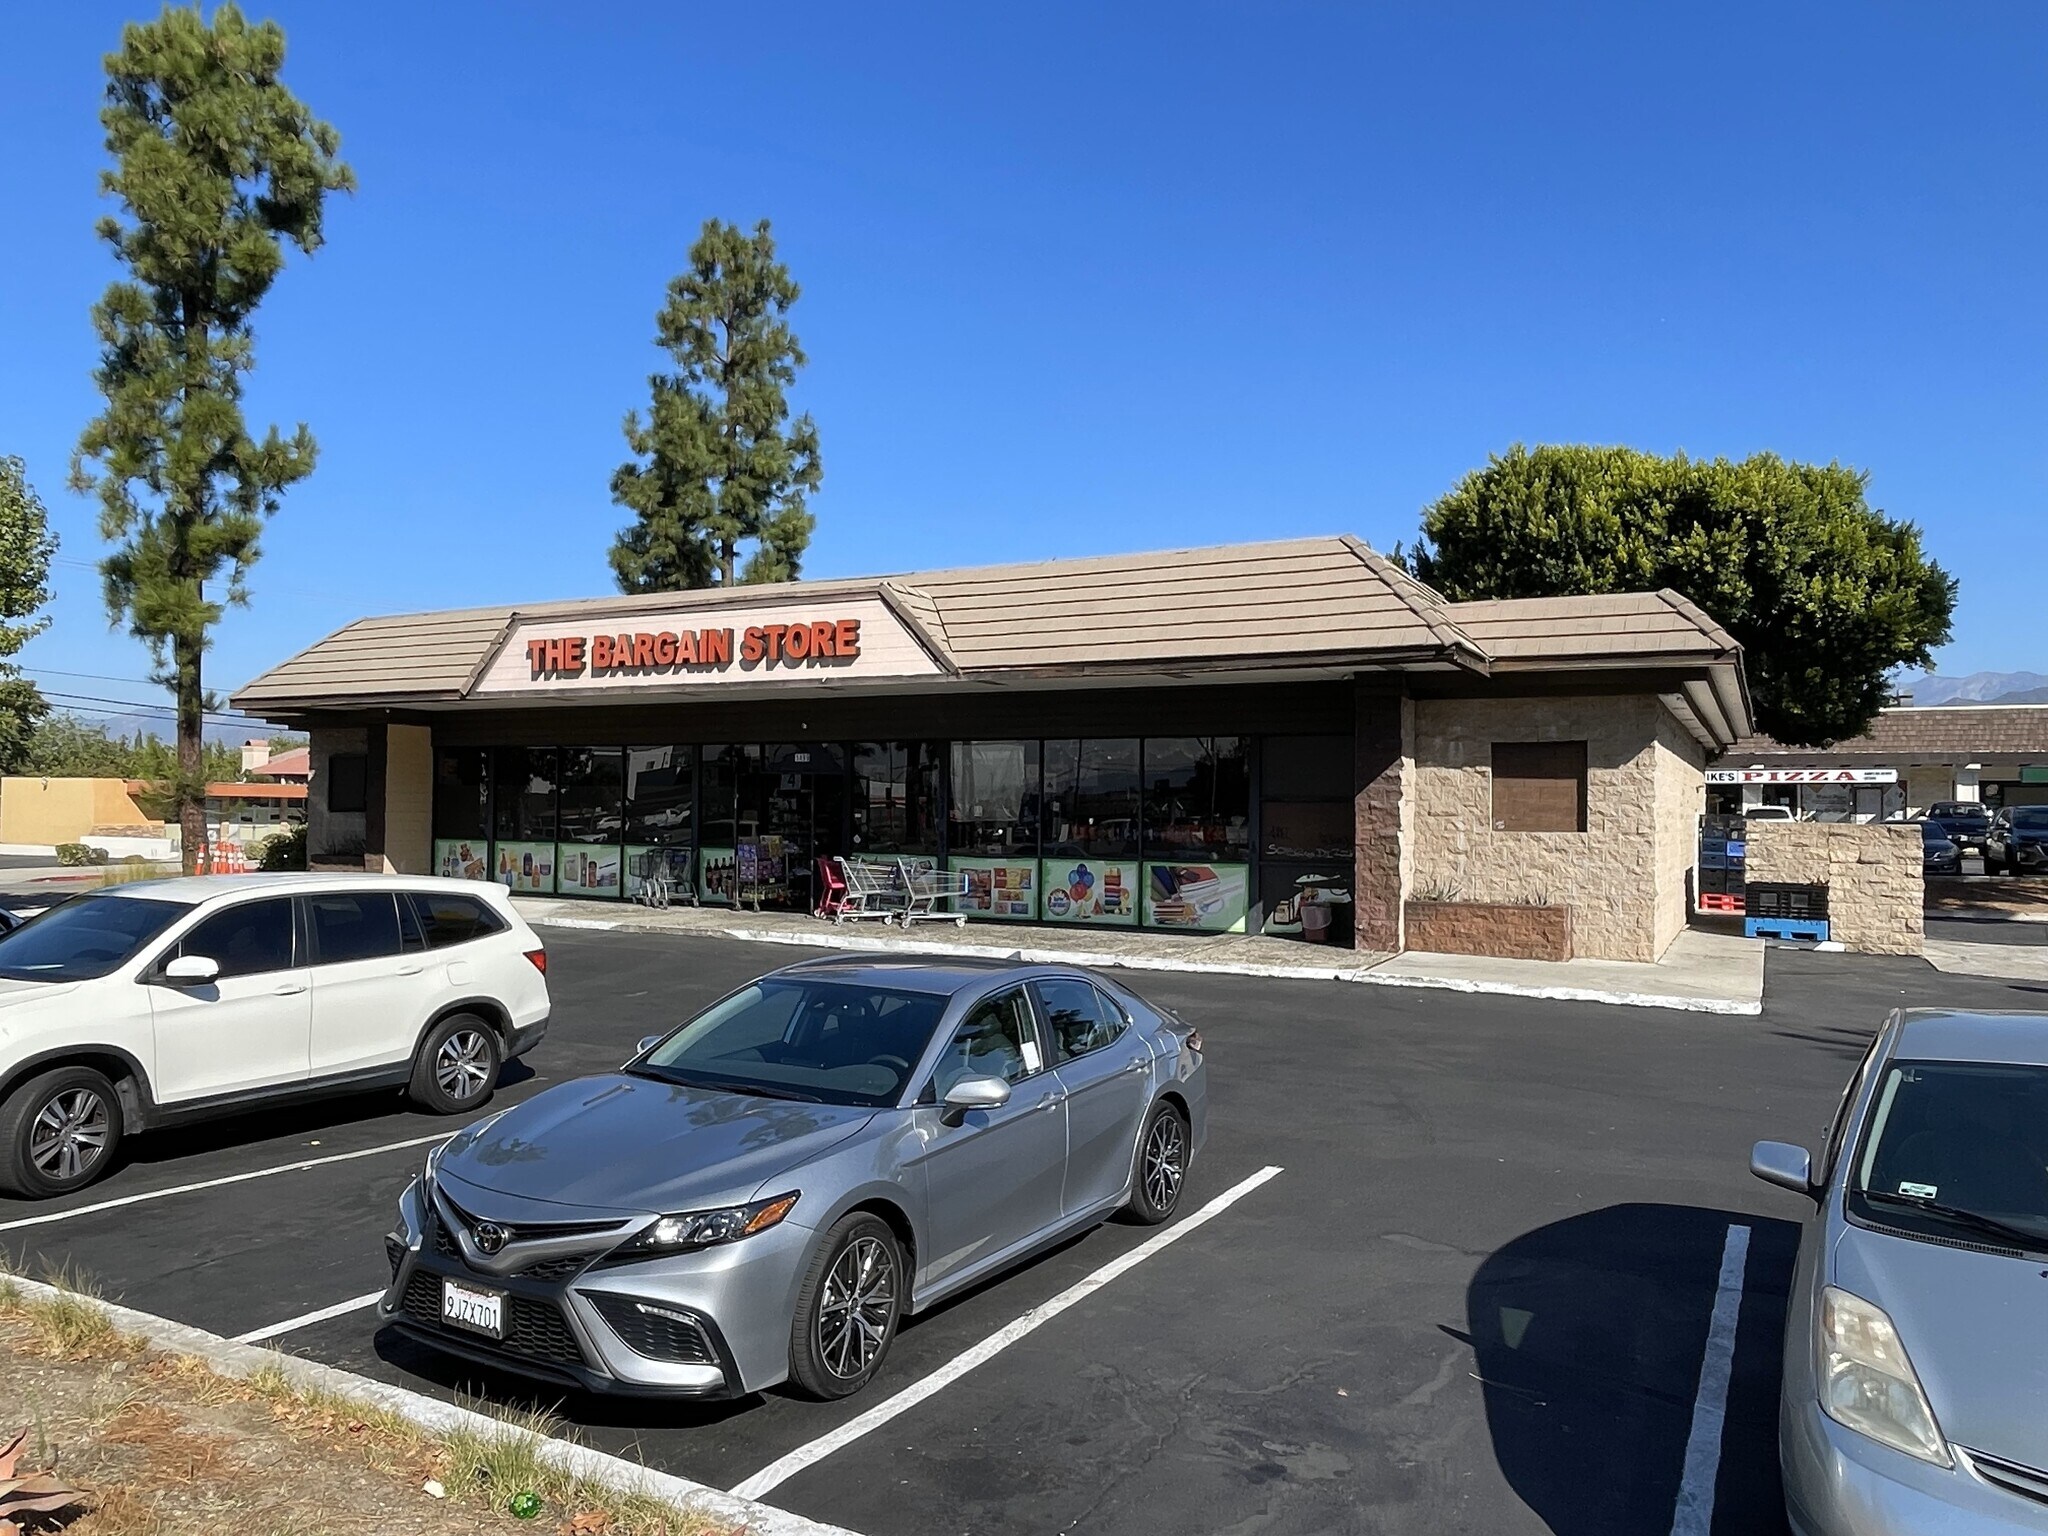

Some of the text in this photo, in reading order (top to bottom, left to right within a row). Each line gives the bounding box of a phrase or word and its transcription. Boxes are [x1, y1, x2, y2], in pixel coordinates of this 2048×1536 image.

[527, 619, 861, 671] THE BARGAIN STORE
[1742, 771, 1858, 782] PIZZA
[447, 1296, 498, 1329] 9JZX701
